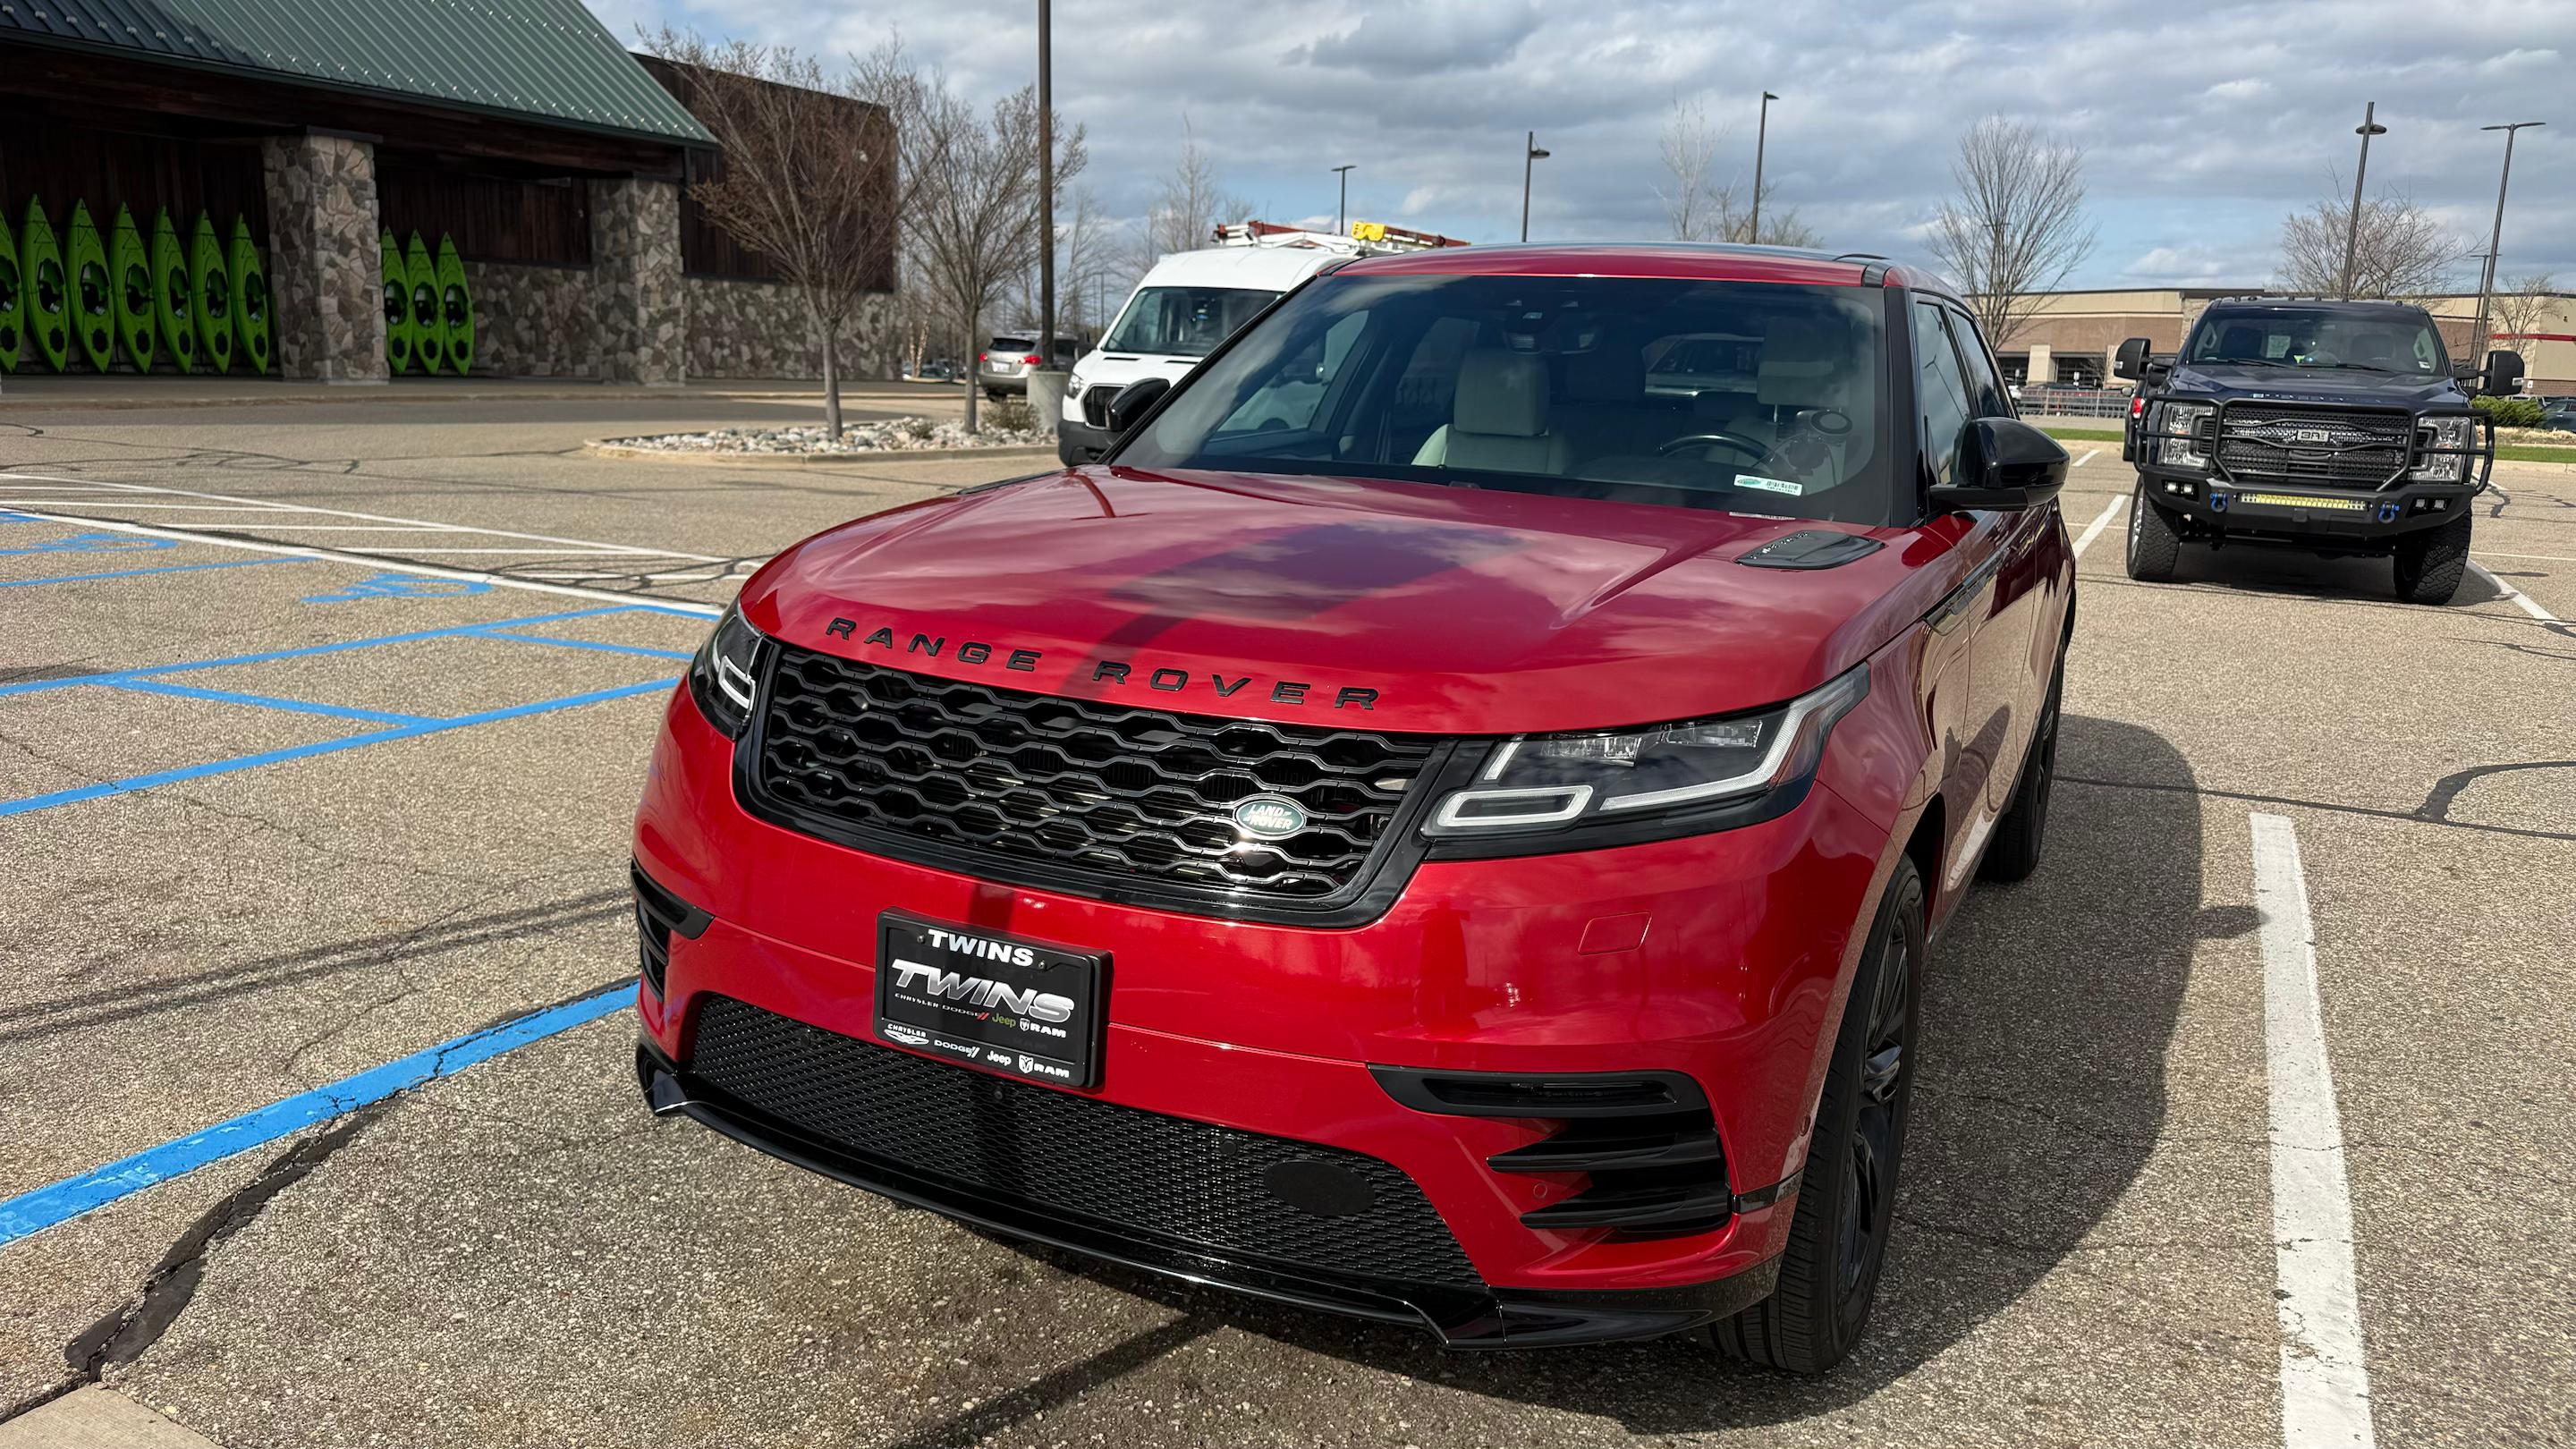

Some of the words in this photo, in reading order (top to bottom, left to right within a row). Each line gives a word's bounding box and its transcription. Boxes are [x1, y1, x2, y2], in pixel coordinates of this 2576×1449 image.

[826, 616, 1042, 672] RANGE
[1092, 660, 1381, 710] ROVER
[1247, 804, 1284, 818] LAND
[1248, 814, 1293, 830] ROVER
[928, 928, 1034, 967] TWINS
[891, 959, 1075, 1023] TWINS
[894, 992, 939, 1008] CHRYSLER
[992, 1013, 1017, 1028] Jeep
[1030, 1022, 1066, 1038] RAM
[887, 1023, 927, 1038] CHRYSLER
[987, 1050, 1013, 1066] Jeep
[1033, 1063, 1070, 1079] RAM
